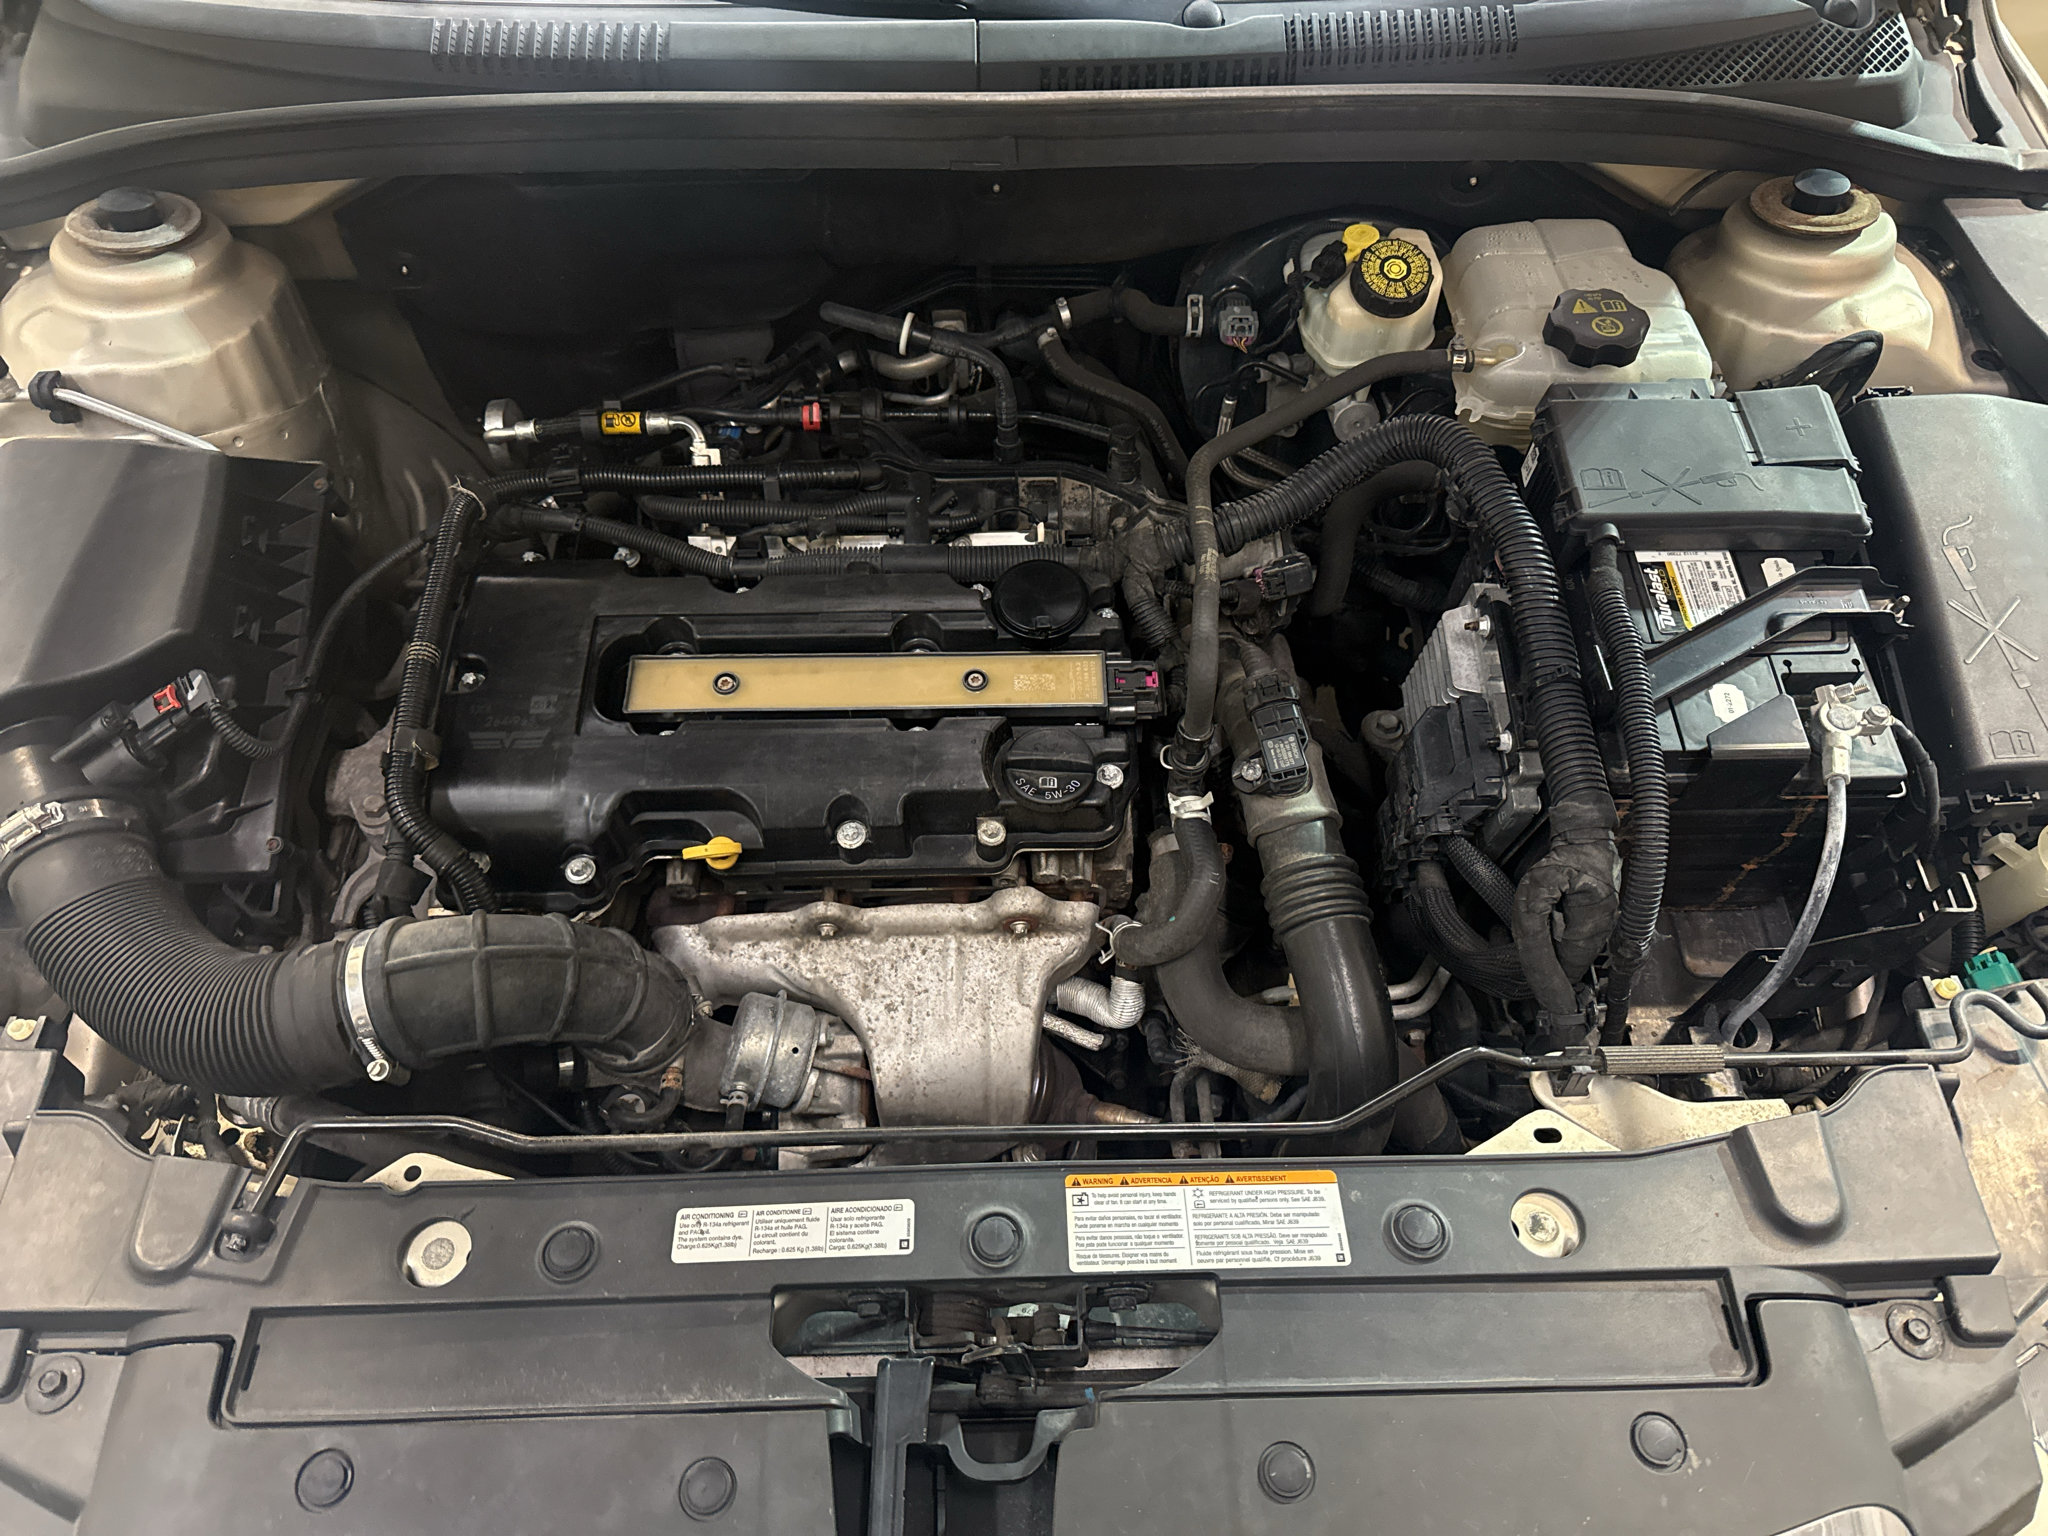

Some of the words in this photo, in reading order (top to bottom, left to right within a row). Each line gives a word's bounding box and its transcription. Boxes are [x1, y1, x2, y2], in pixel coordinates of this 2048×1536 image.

[1659, 569, 1672, 596] GOLD
[1670, 576, 1682, 596] TOUGH
[1643, 568, 1676, 628] Duralast
[1677, 597, 1690, 622] PROVEN
[1015, 777, 1036, 797] SAE
[1044, 779, 1080, 800] 5W-30
